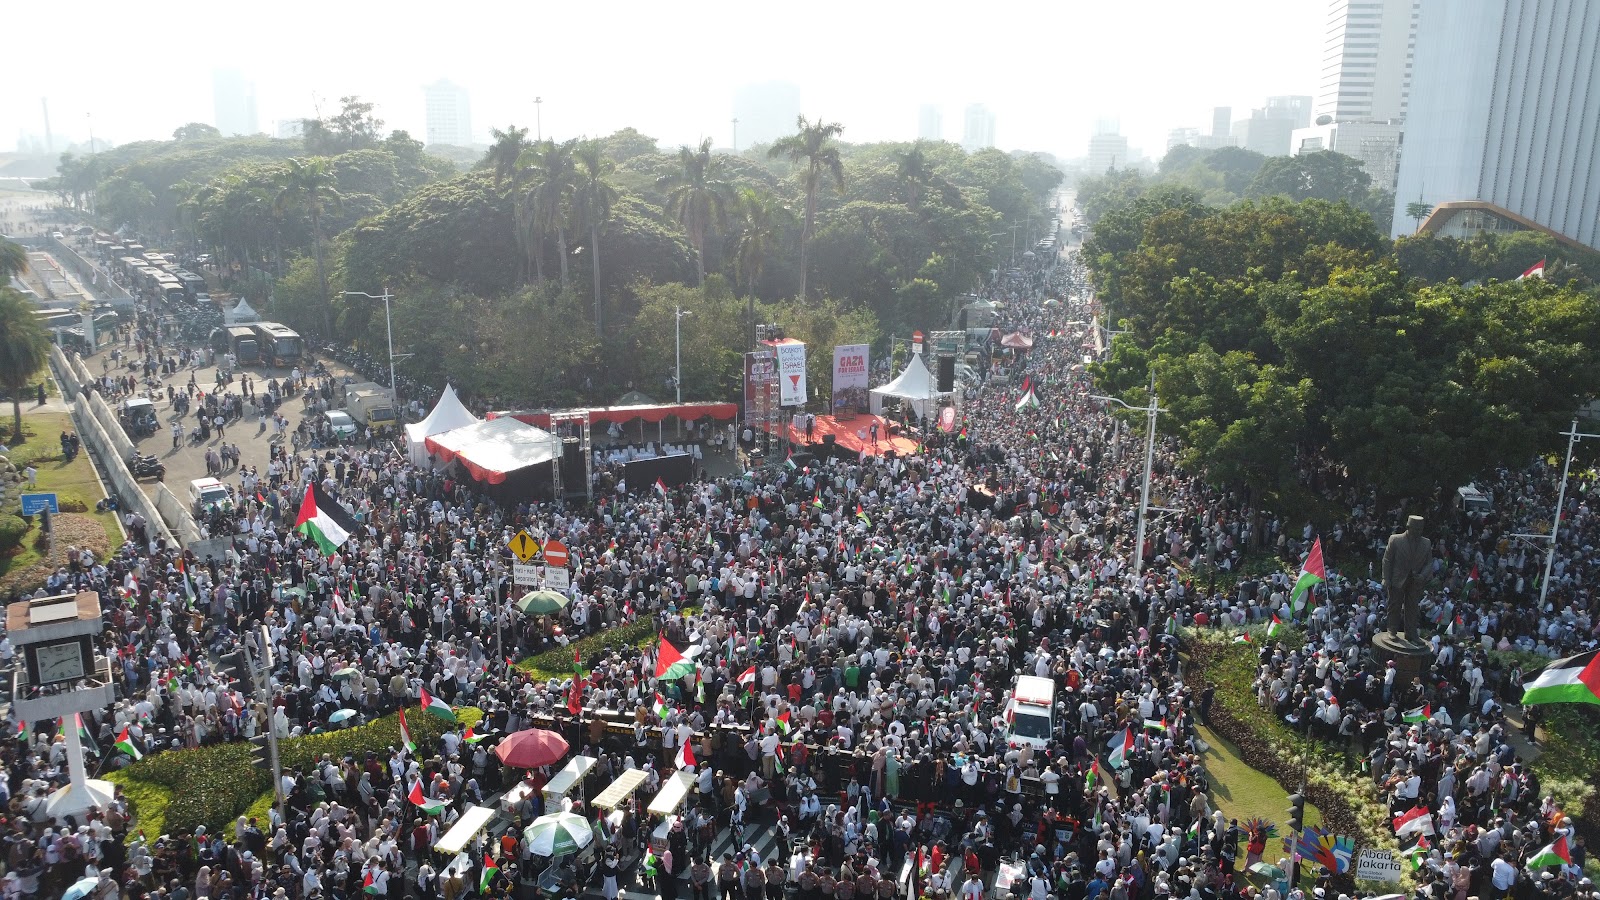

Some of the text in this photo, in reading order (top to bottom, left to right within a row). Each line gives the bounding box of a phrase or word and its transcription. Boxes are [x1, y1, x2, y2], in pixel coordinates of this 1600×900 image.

[840, 355, 864, 367] GAZA
[1360, 850, 1392, 860] Abad
[1358, 860, 1401, 870] Jakarta
